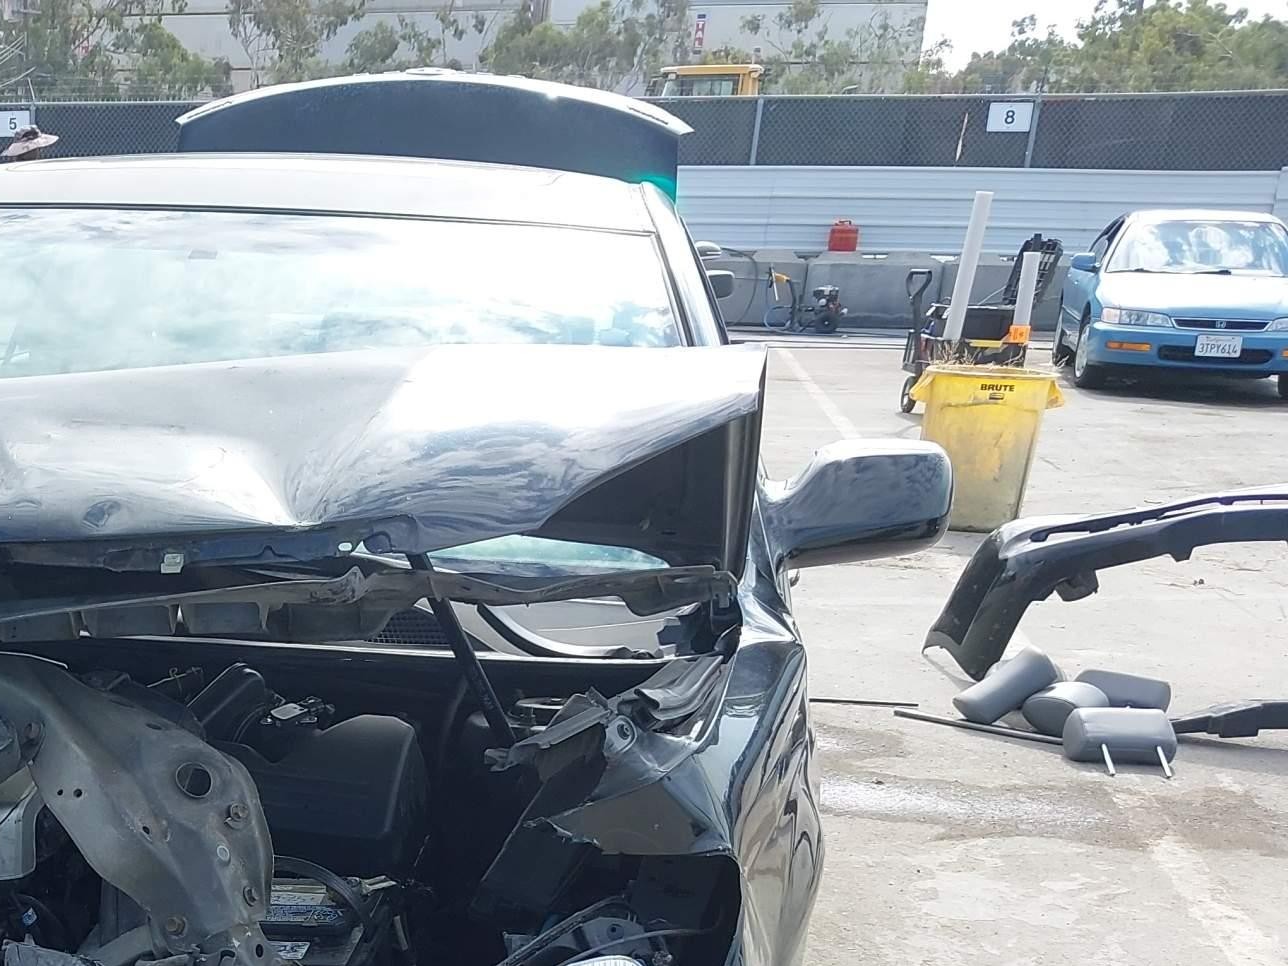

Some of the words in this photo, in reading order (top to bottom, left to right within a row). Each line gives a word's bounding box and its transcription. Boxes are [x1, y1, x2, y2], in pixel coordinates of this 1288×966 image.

[9, 117, 17, 130] 5
[1004, 110, 1016, 125] 8
[980, 383, 1015, 392] BRUTE
